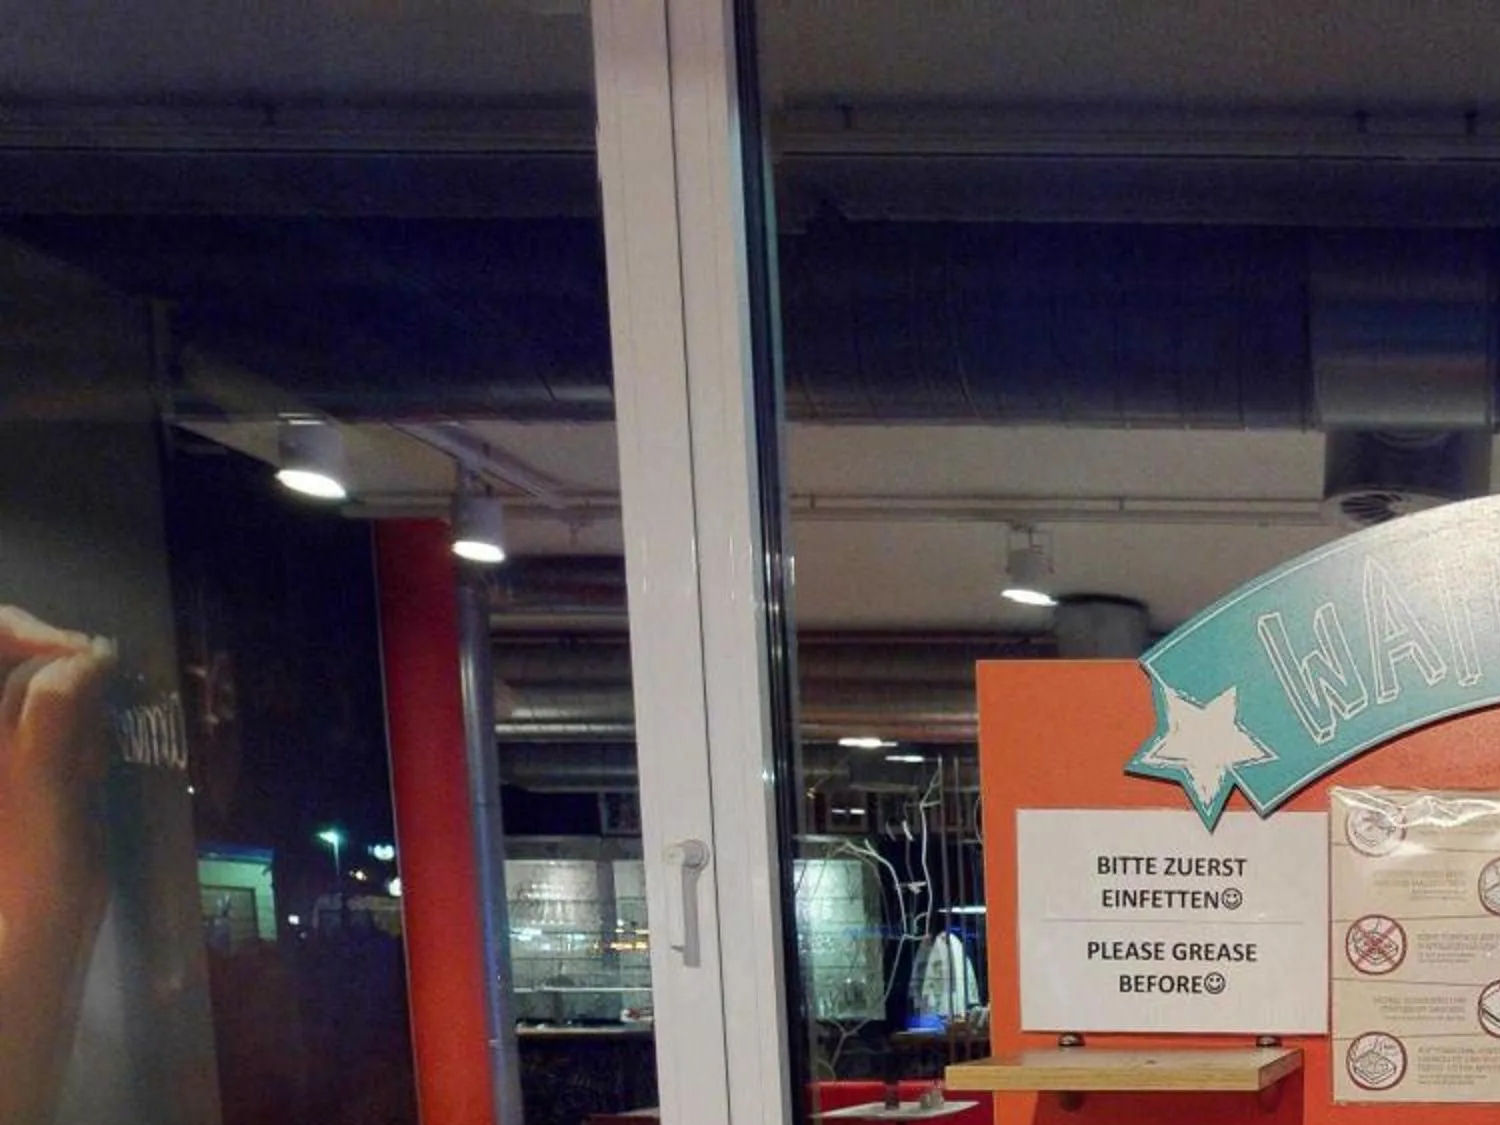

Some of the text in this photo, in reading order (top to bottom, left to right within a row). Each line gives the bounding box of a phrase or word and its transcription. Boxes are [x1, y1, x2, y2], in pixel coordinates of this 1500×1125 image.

[1097, 856, 1248, 877] BITTE ZUERST
[1101, 888, 1219, 909] EINFETTEN
[1087, 941, 1258, 962] PLEASE GREASE
[1119, 974, 1203, 994] BEFORE
